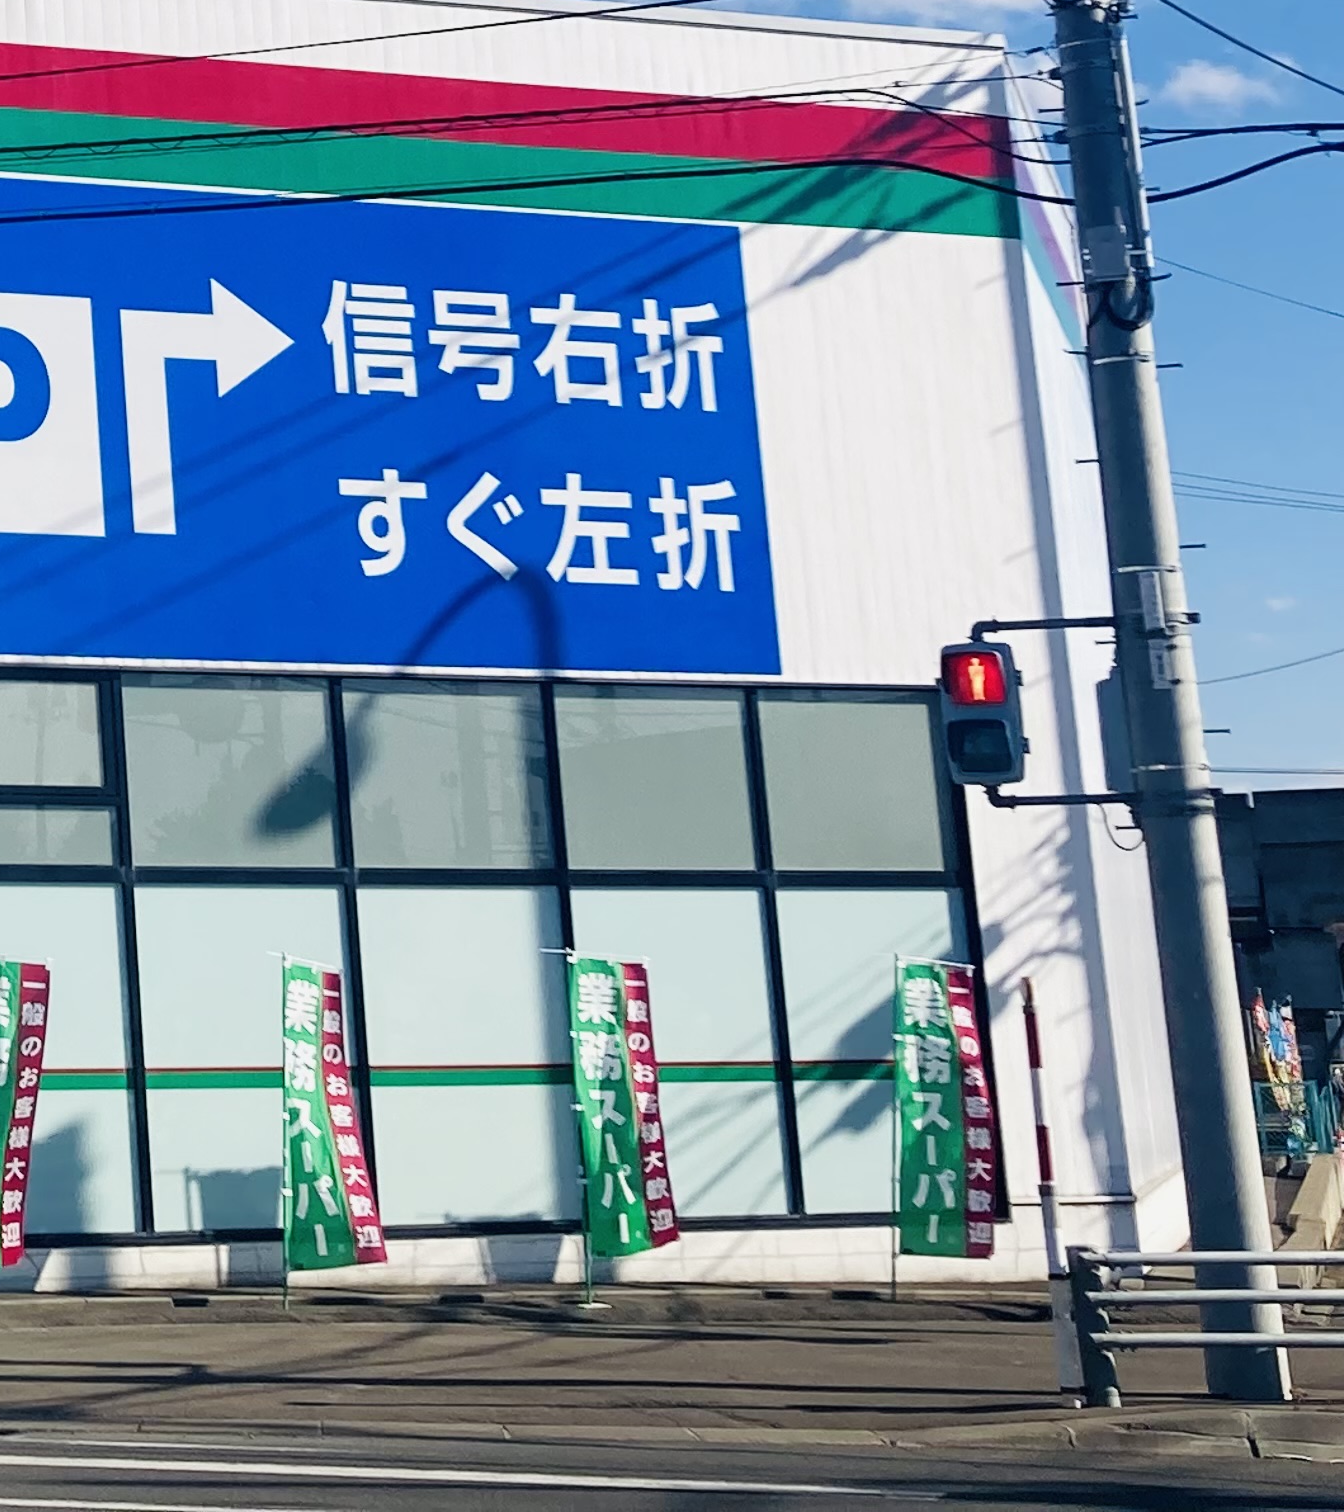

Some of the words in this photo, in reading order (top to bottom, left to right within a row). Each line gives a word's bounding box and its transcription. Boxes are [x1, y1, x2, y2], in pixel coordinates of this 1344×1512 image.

[321, 279, 725, 412] 信号右折
[338, 468, 741, 593] すぐ左折
[1, 980, 47, 1249] 一般のお客様大歓迎
[284, 979, 341, 1256] 業務スーパー
[323, 988, 381, 1248] 一般のお客様大歓迎
[577, 972, 637, 1243] 業務スーパー
[904, 977, 957, 1243] 業務スーパー
